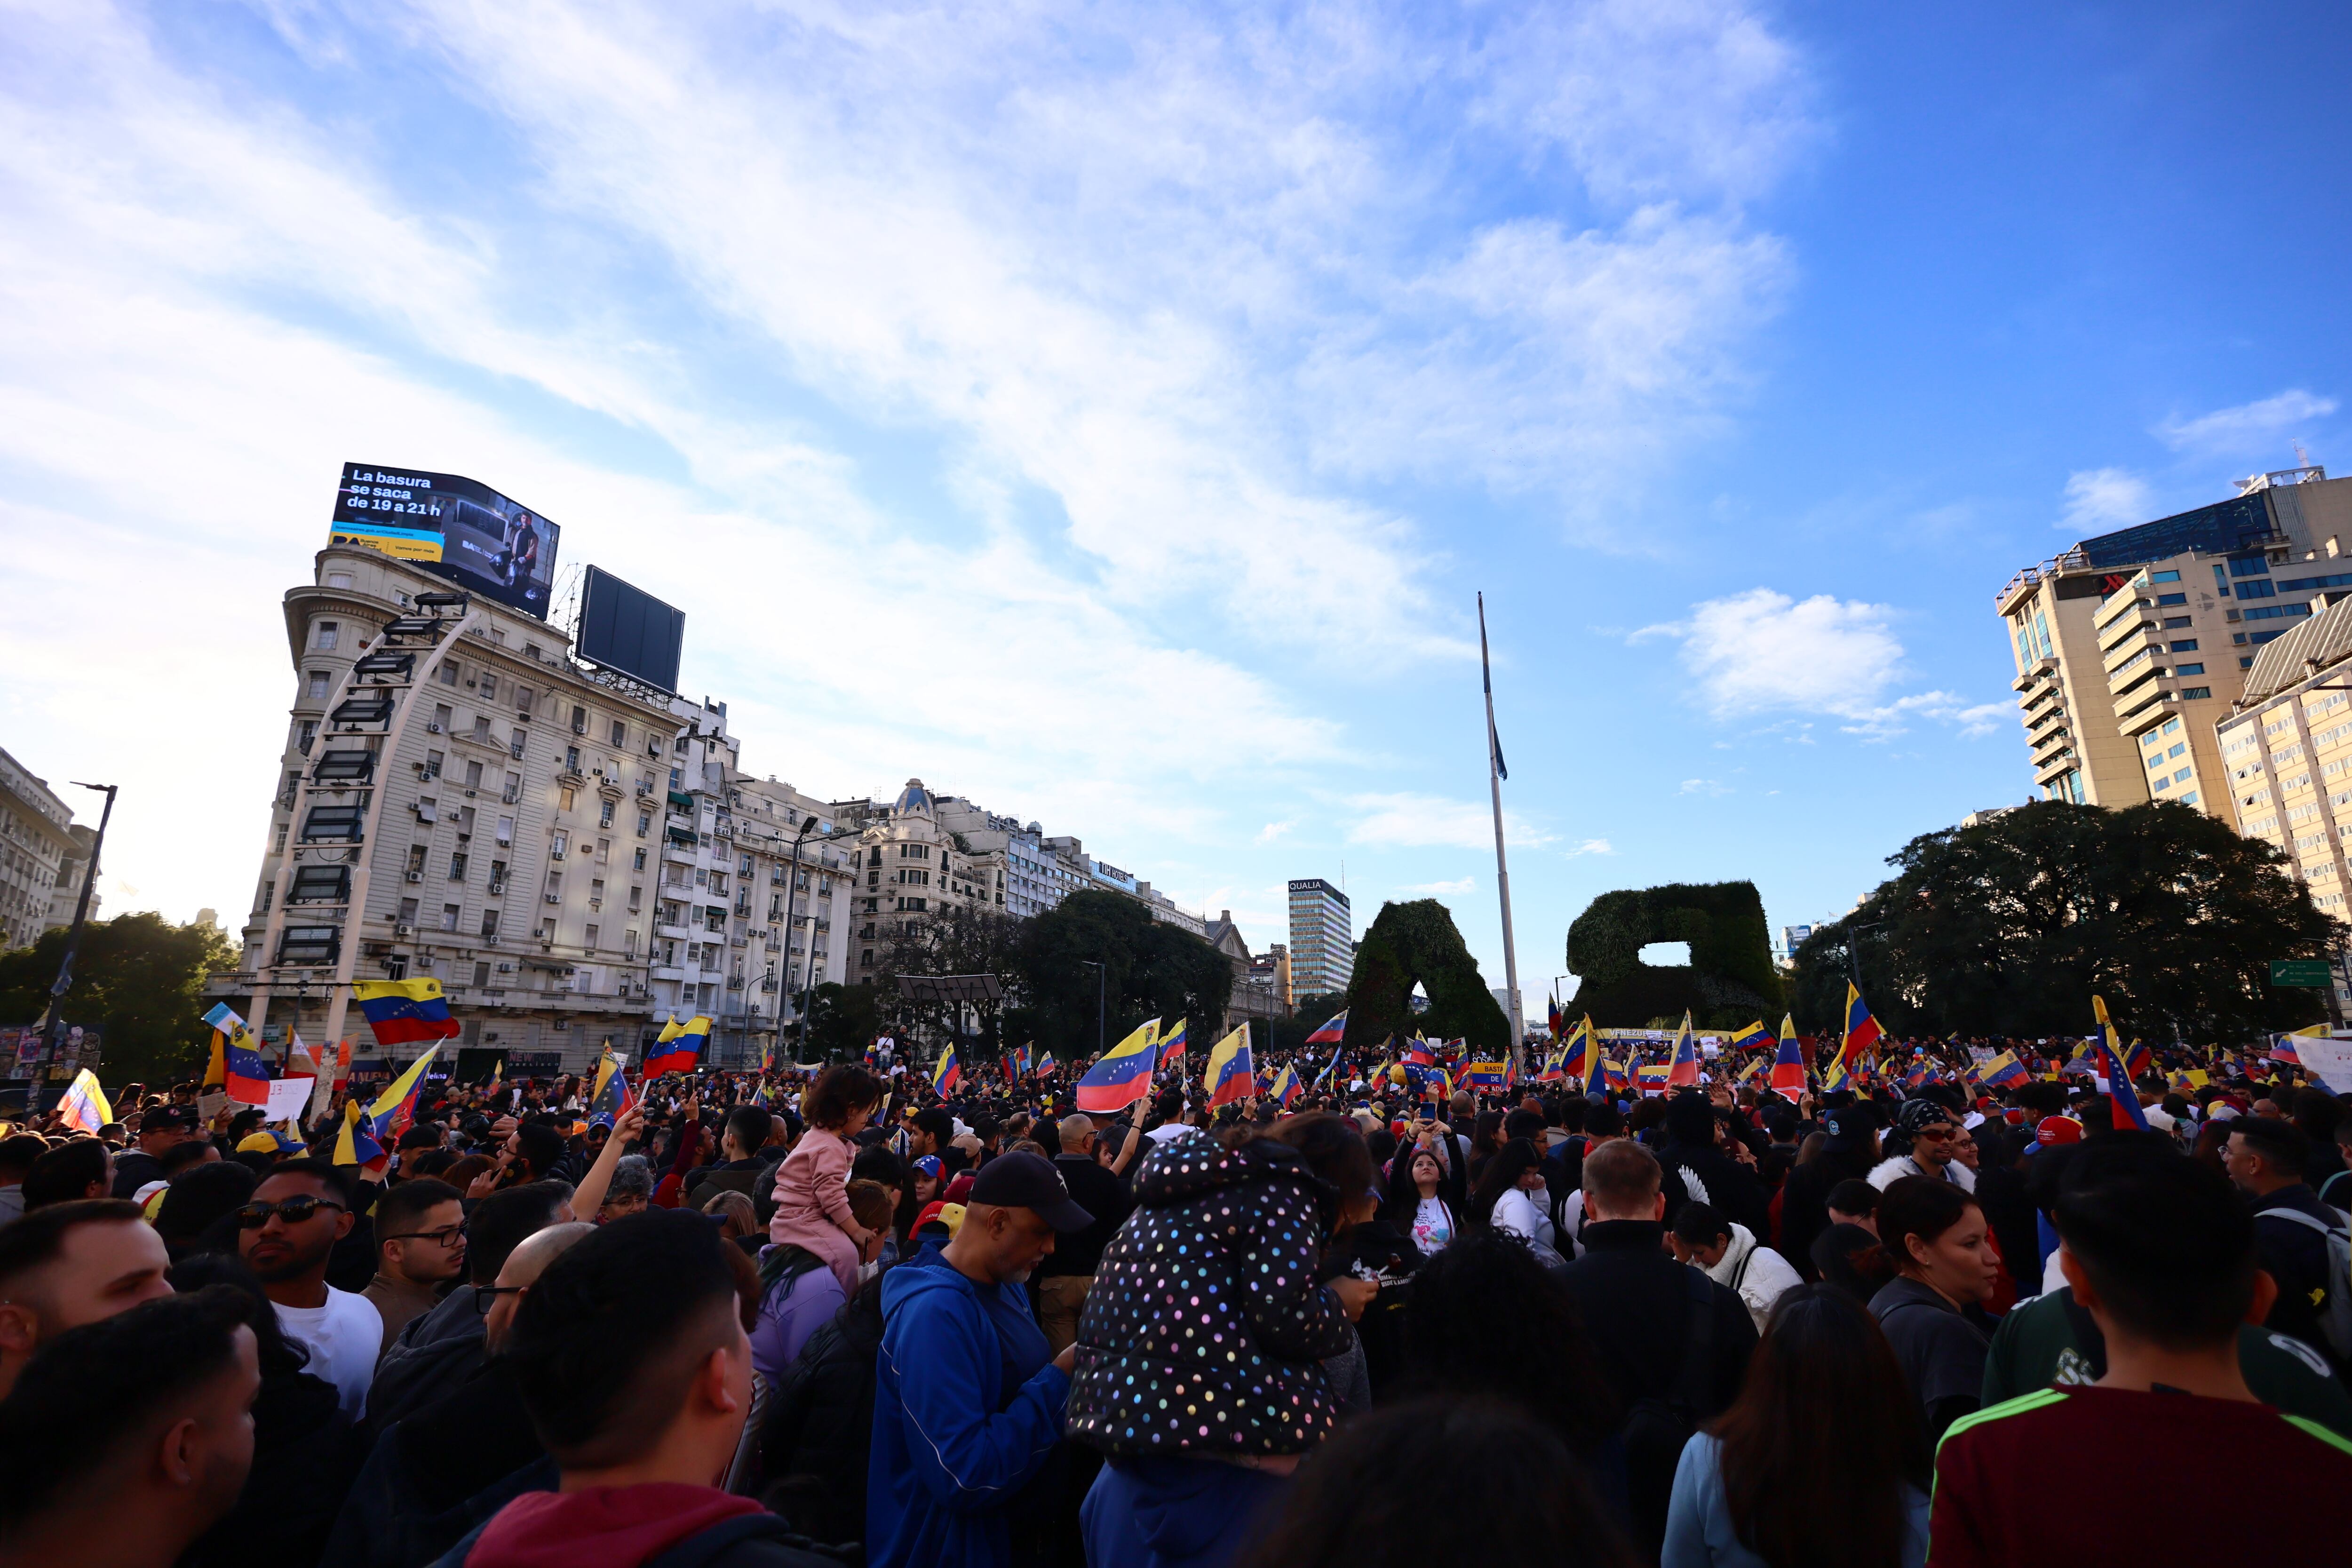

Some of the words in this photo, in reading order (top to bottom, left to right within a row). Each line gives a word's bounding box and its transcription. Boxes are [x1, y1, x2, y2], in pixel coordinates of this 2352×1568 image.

[353, 470, 373, 482] La
[376, 471, 431, 488] basura
[350, 485, 370, 494] se
[373, 487, 411, 500] saca
[347, 496, 368, 508] de
[371, 499, 391, 510] 19
[394, 503, 405, 512] a
[406, 502, 427, 515] 21
[430, 504, 441, 517] h
[1112, 869, 1128, 883] HOTELS
[1289, 882, 1321, 890] QUALIA
